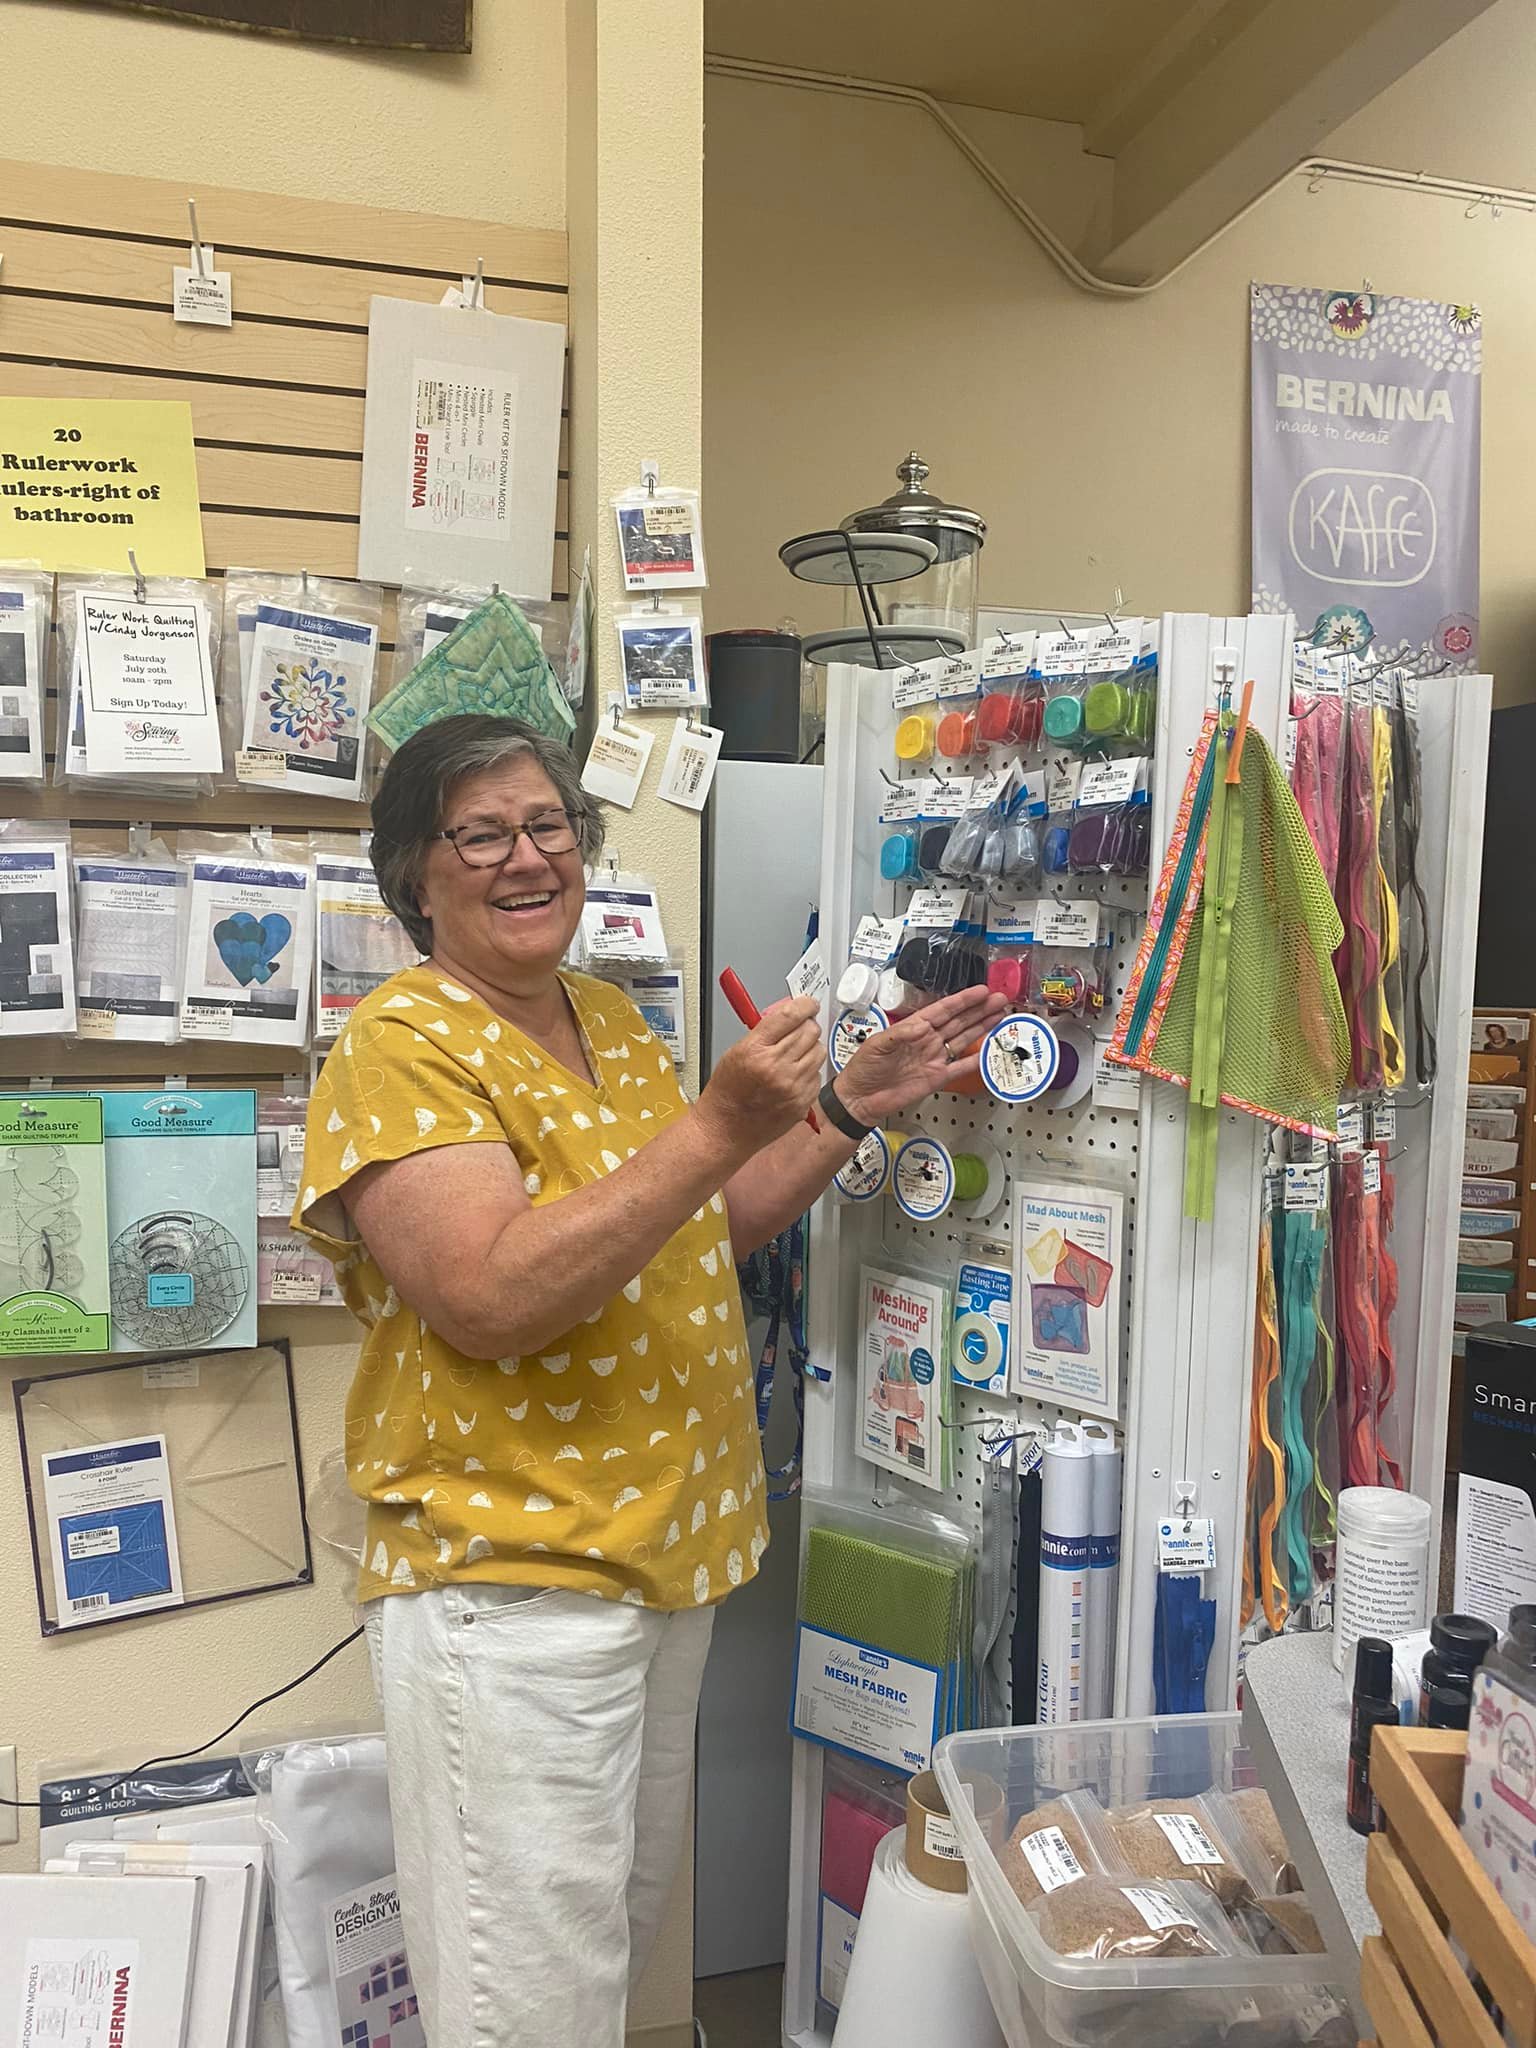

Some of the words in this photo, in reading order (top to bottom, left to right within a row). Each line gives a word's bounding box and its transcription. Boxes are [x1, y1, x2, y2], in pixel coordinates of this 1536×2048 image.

[503, 392, 512, 416] RULER
[1276, 373, 1455, 424] BERNINA
[502, 417, 510, 428] KIT
[1275, 418, 1320, 435] made
[1324, 421, 1340, 439] to
[1344, 427, 1390, 445] create
[53, 429, 82, 442] 20
[501, 431, 510, 446] FOR
[2, 454, 138, 473] Rulerwork
[412, 433, 429, 508] BERNINA
[0, 481, 131, 502] ulers-right
[137, 485, 161, 500] of
[498, 488, 506, 521] MODELS
[14, 507, 134, 524] bathroom
[87, 607, 118, 620] Ruler
[122, 612, 149, 624] Work
[153, 615, 195, 628] Quilting
[89, 620, 137, 639] w/Cindy
[141, 627, 195, 640] Jorgenson
[123, 654, 166, 664] Saturday
[125, 665, 145, 674] July
[148, 666, 167, 674] 20th
[122, 676, 145, 684] 10am
[153, 678, 172, 686] 2pm
[110, 697, 134, 708] Sign
[136, 698, 150, 710] Up
[152, 700, 188, 710] Today!
[132, 721, 178, 744] Sewing
[110, 888, 144, 896] Feathered
[240, 889, 262, 898] Hearts
[25, 1121, 79, 1131] Measure
[132, 1117, 161, 1128] Good
[164, 1118, 213, 1127] Measure
[1474, 1189, 1500, 1198] YOUR
[1027, 1204, 1047, 1216] Mad
[1048, 1207, 1078, 1220] About
[1080, 1211, 1106, 1224] Mesh
[268, 1243, 302, 1252] SHANK
[962, 1274, 990, 1289] Basting
[992, 1280, 1010, 1292] Tape
[872, 1286, 928, 1324] Meshing
[878, 1308, 920, 1334] Around
[14, 1327, 56, 1336] Clamshell
[74, 1326, 84, 1334] of
[1021, 1441, 1042, 1468] sport
[80, 1469, 114, 1480] Crosshair
[115, 1466, 134, 1474] Ruler
[1365, 1575, 1382, 1584] fabric
[1358, 1584, 1392, 1596] powdered
[1372, 1598, 1408, 1606] parchment
[1358, 1614, 1375, 1623] apply
[827, 1649, 880, 1676] Lightweight
[824, 1665, 858, 1686] MESH
[862, 1678, 908, 1704] FABRIC
[1039, 1662, 1048, 1702] Clear
[60, 1803, 103, 1817] QUILTING
[105, 1799, 137, 1810] HOOPS
[334, 1902, 366, 1923] Center
[370, 1890, 396, 1908] Stage
[336, 1906, 386, 1938] DESIGN
